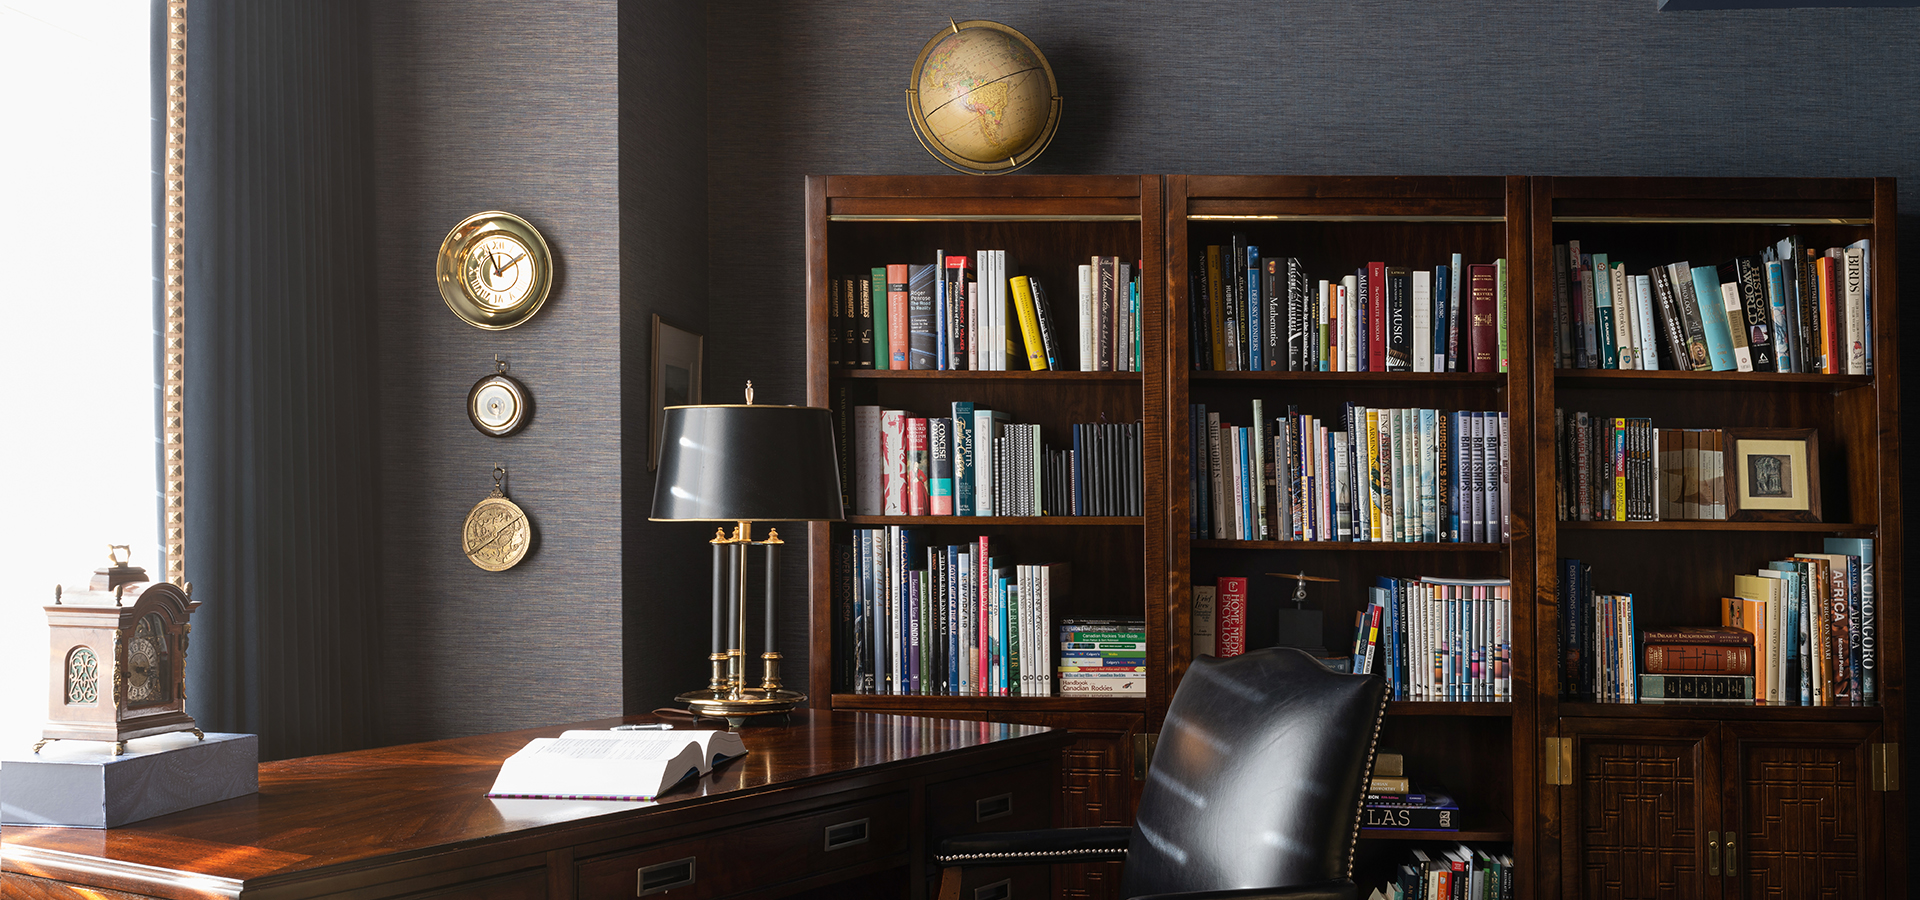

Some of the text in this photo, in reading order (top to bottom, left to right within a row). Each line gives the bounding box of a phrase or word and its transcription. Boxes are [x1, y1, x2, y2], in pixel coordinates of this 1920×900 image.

[1848, 255, 1860, 293] BIRDS
[846, 279, 854, 318] MATHEMATICS
[862, 279, 870, 318] MATHEMATICS
[1742, 270, 1758, 325] WORLD
[1751, 266, 1766, 325] HISTORY
[1269, 297, 1278, 347] Mathematics
[1393, 308, 1402, 344] MUSIC
[938, 423, 946, 458] CONCISE
[1210, 420, 1220, 478] SHIP MODELS
[1439, 415, 1447, 477] CHURCHILL'S
[1578, 427, 1586, 471] COMPLETE
[1460, 436, 1470, 491] BATTLESHIPS
[1473, 437, 1483, 492] BATTLESHIPS
[1486, 437, 1497, 492] BATTLESHIPS
[863, 537, 872, 580] OVER EUROPE
[874, 536, 883, 607] OVER CHINA
[900, 551, 908, 584] CANADA
[940, 573, 946, 582] DU
[950, 600, 956, 609] OF
[1231, 594, 1240, 625] HOME
[1833, 570, 1844, 622] AFRICA
[1852, 596, 1858, 605] OF
[1861, 563, 1875, 670] NGORONGORO
[941, 626, 946, 635] LA
[1824, 625, 1830, 635] ON
[1851, 608, 1860, 649] AFRICA
